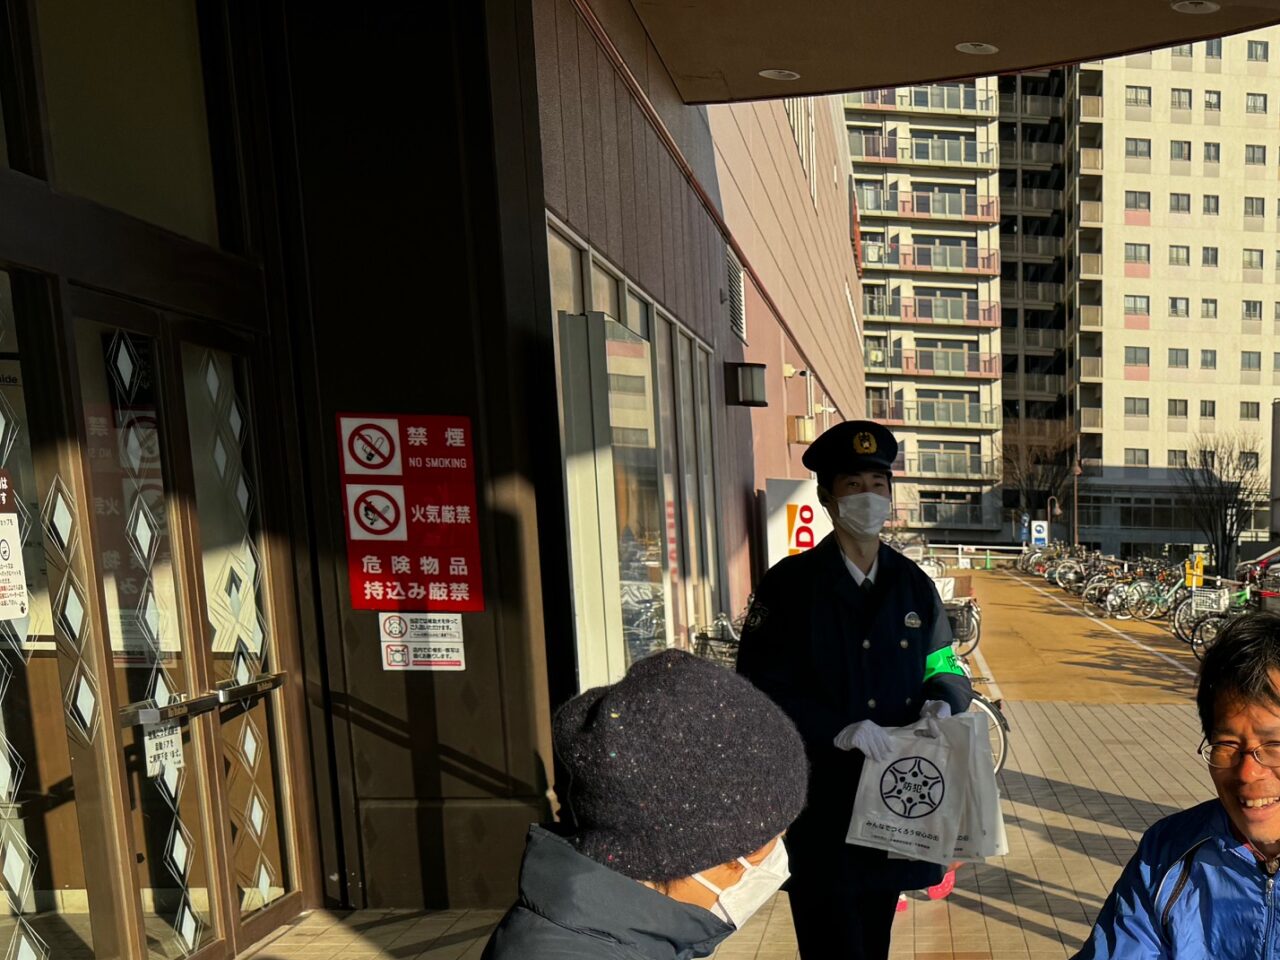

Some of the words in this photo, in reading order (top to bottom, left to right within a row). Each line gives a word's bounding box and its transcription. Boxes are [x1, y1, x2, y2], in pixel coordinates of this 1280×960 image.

[406, 426, 466, 447] 禁煙
[408, 457, 422, 468] NO
[425, 458, 467, 469] SMOKING
[411, 504, 471, 524] 火気厳禁
[362, 555, 468, 576] 危険物品
[364, 581, 470, 602] 持込み厳禁
[902, 781, 923, 794] 防犯
